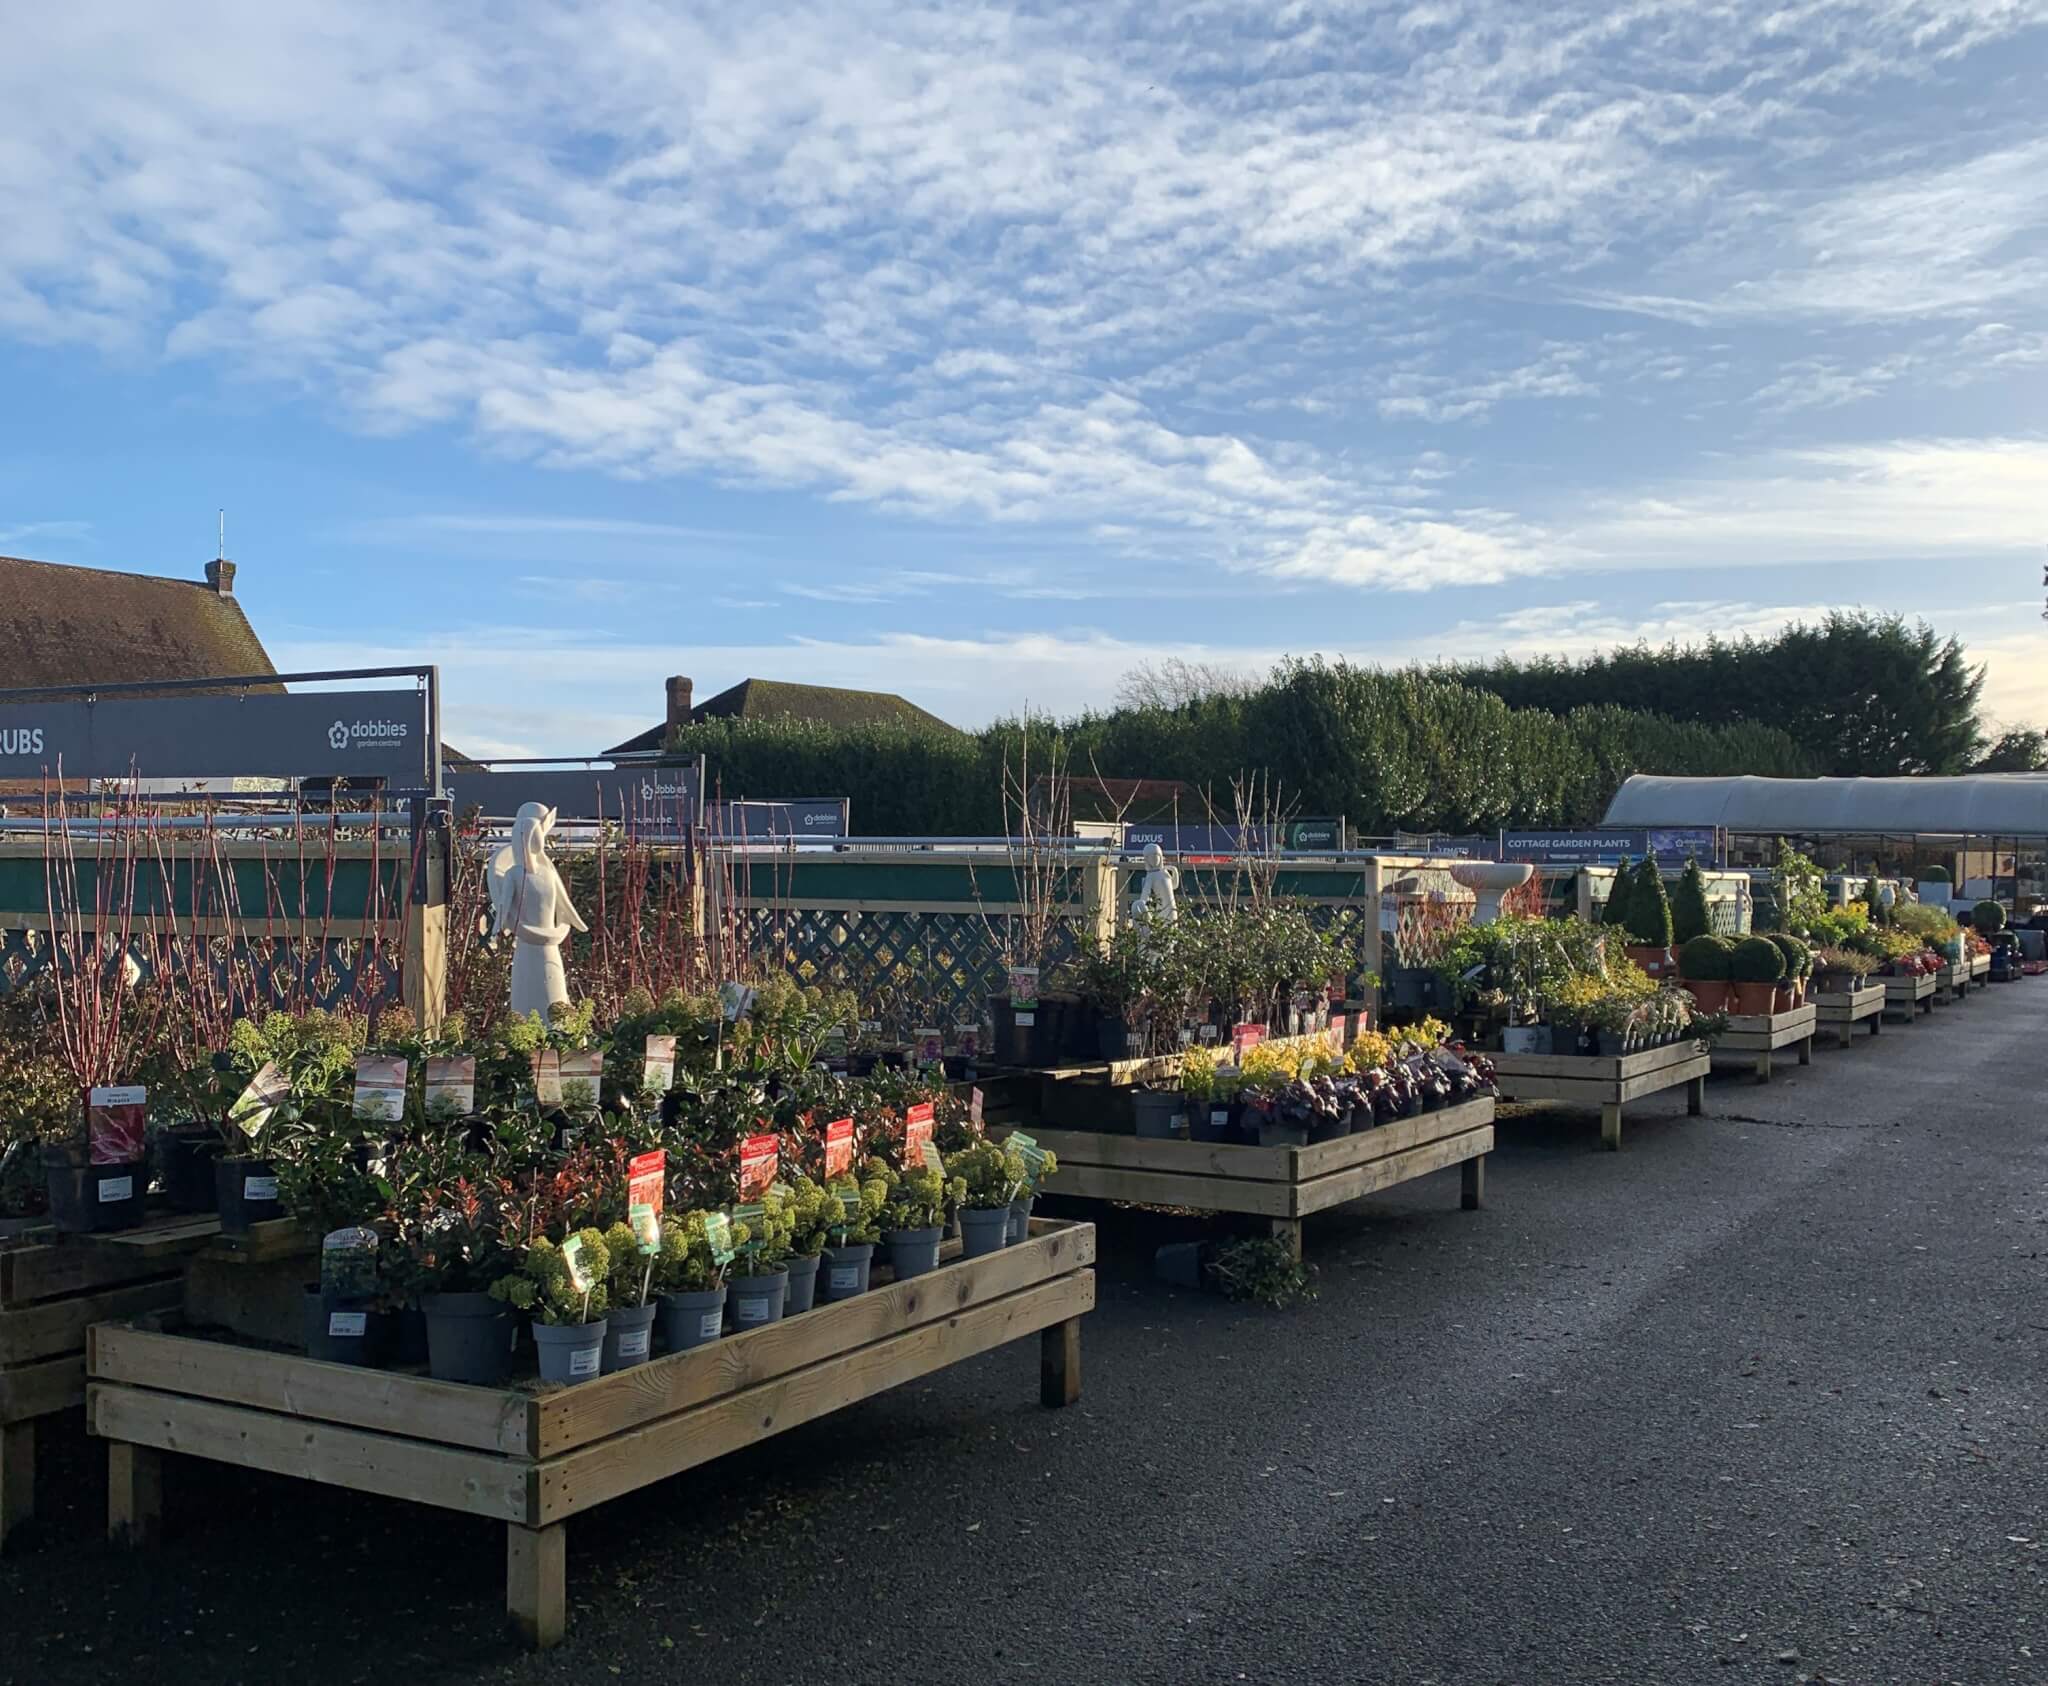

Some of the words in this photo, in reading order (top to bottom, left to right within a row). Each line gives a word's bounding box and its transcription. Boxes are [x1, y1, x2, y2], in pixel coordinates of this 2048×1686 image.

[351, 719, 407, 737] dobbies
[0, 728, 44, 754] UBS
[1131, 834, 1163, 843] BUXUS
[1508, 840, 1550, 848] COTTAGE
[1552, 840, 1591, 848] GARDEN
[1593, 840, 1631, 848] PLANTS
